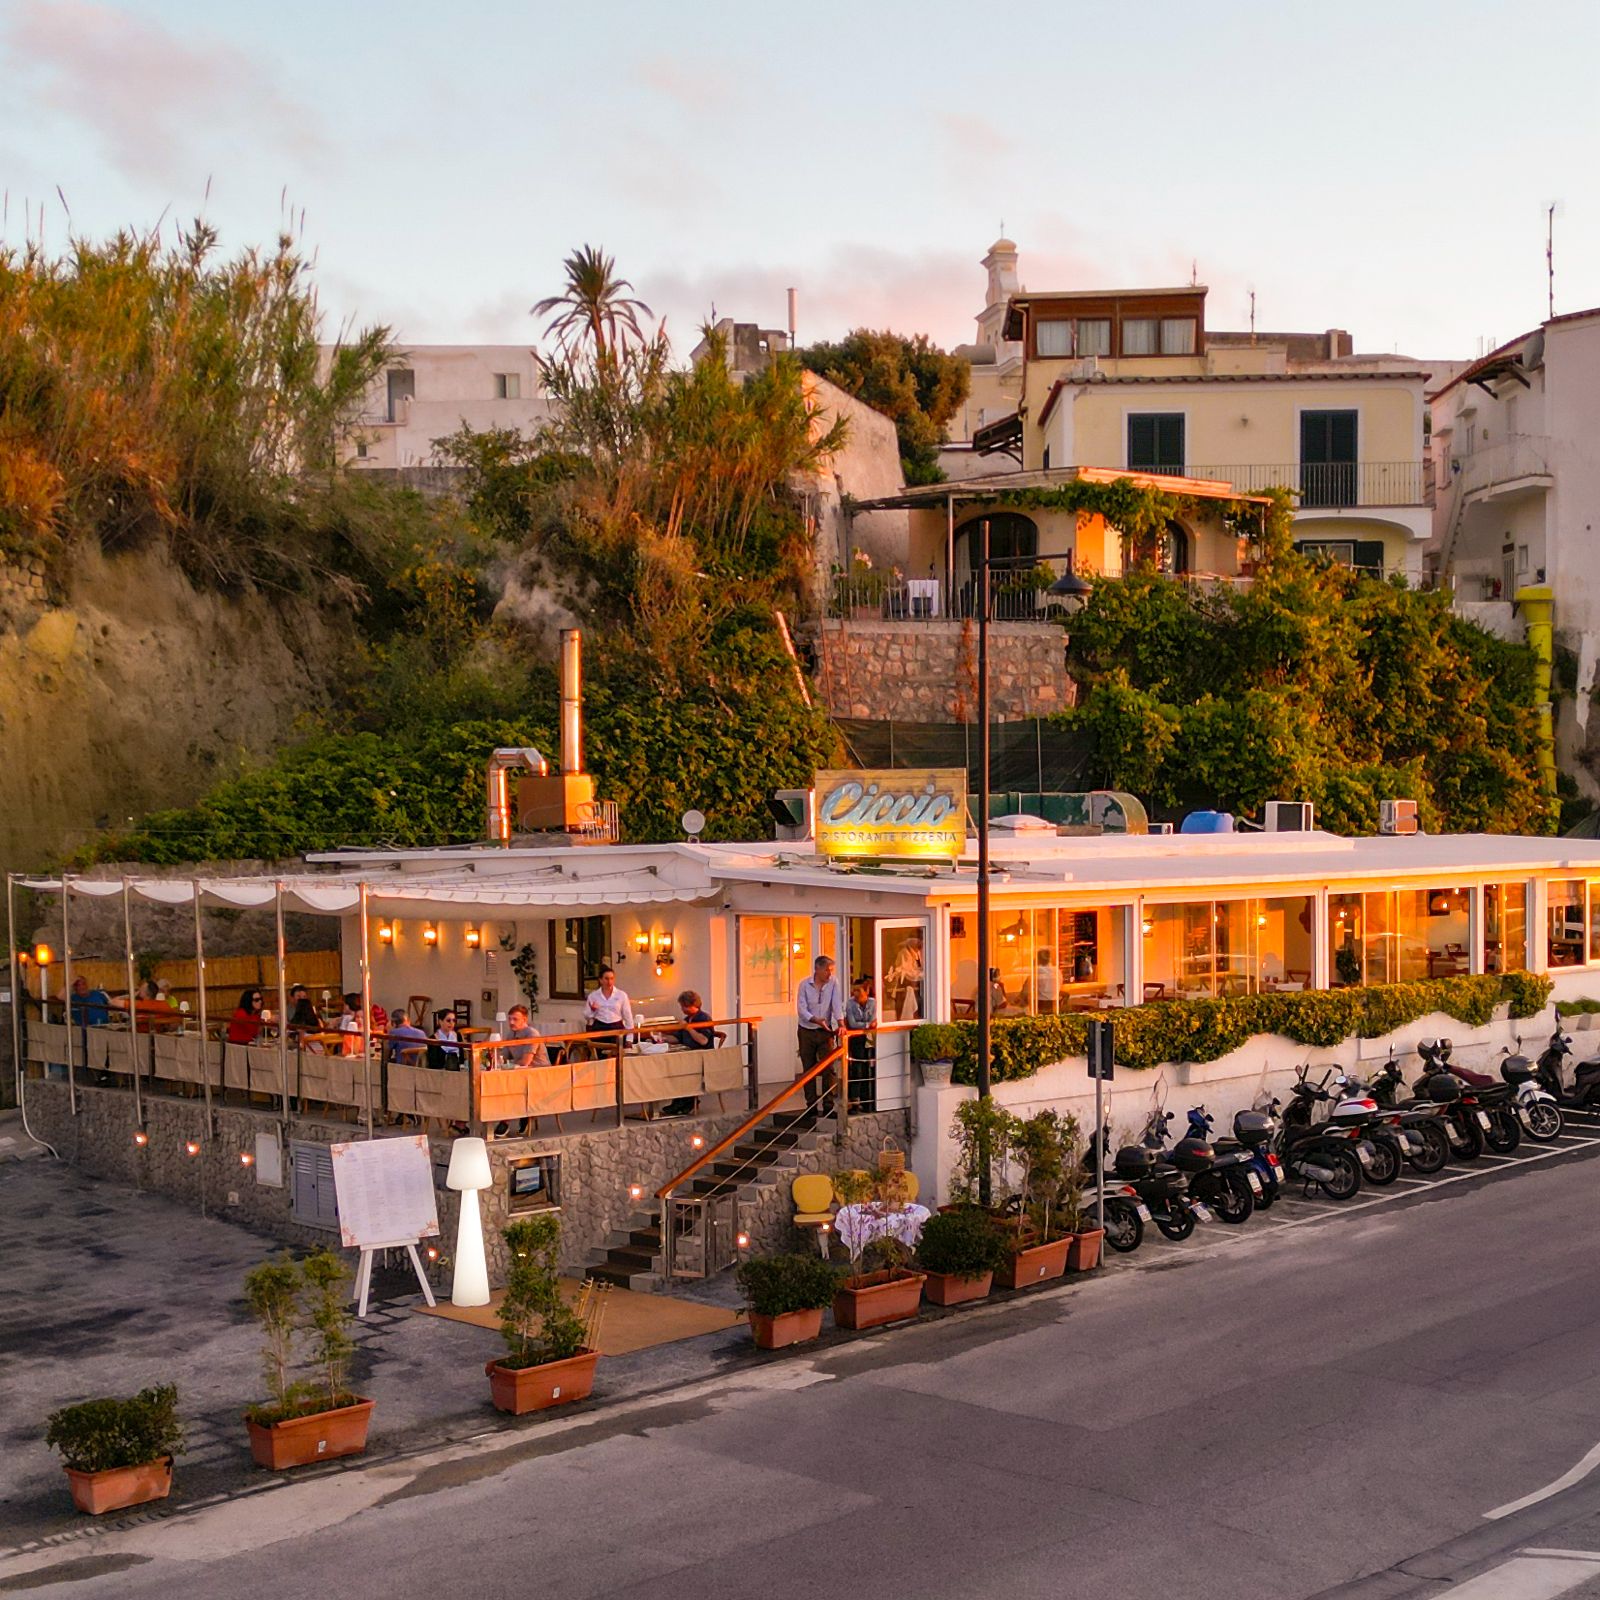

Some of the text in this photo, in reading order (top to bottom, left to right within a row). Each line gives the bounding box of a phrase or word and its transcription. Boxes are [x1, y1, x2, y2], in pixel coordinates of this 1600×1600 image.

[821, 782, 957, 826] Ciccio
[821, 831, 957, 842] RISTORANTE PIZZERIA
